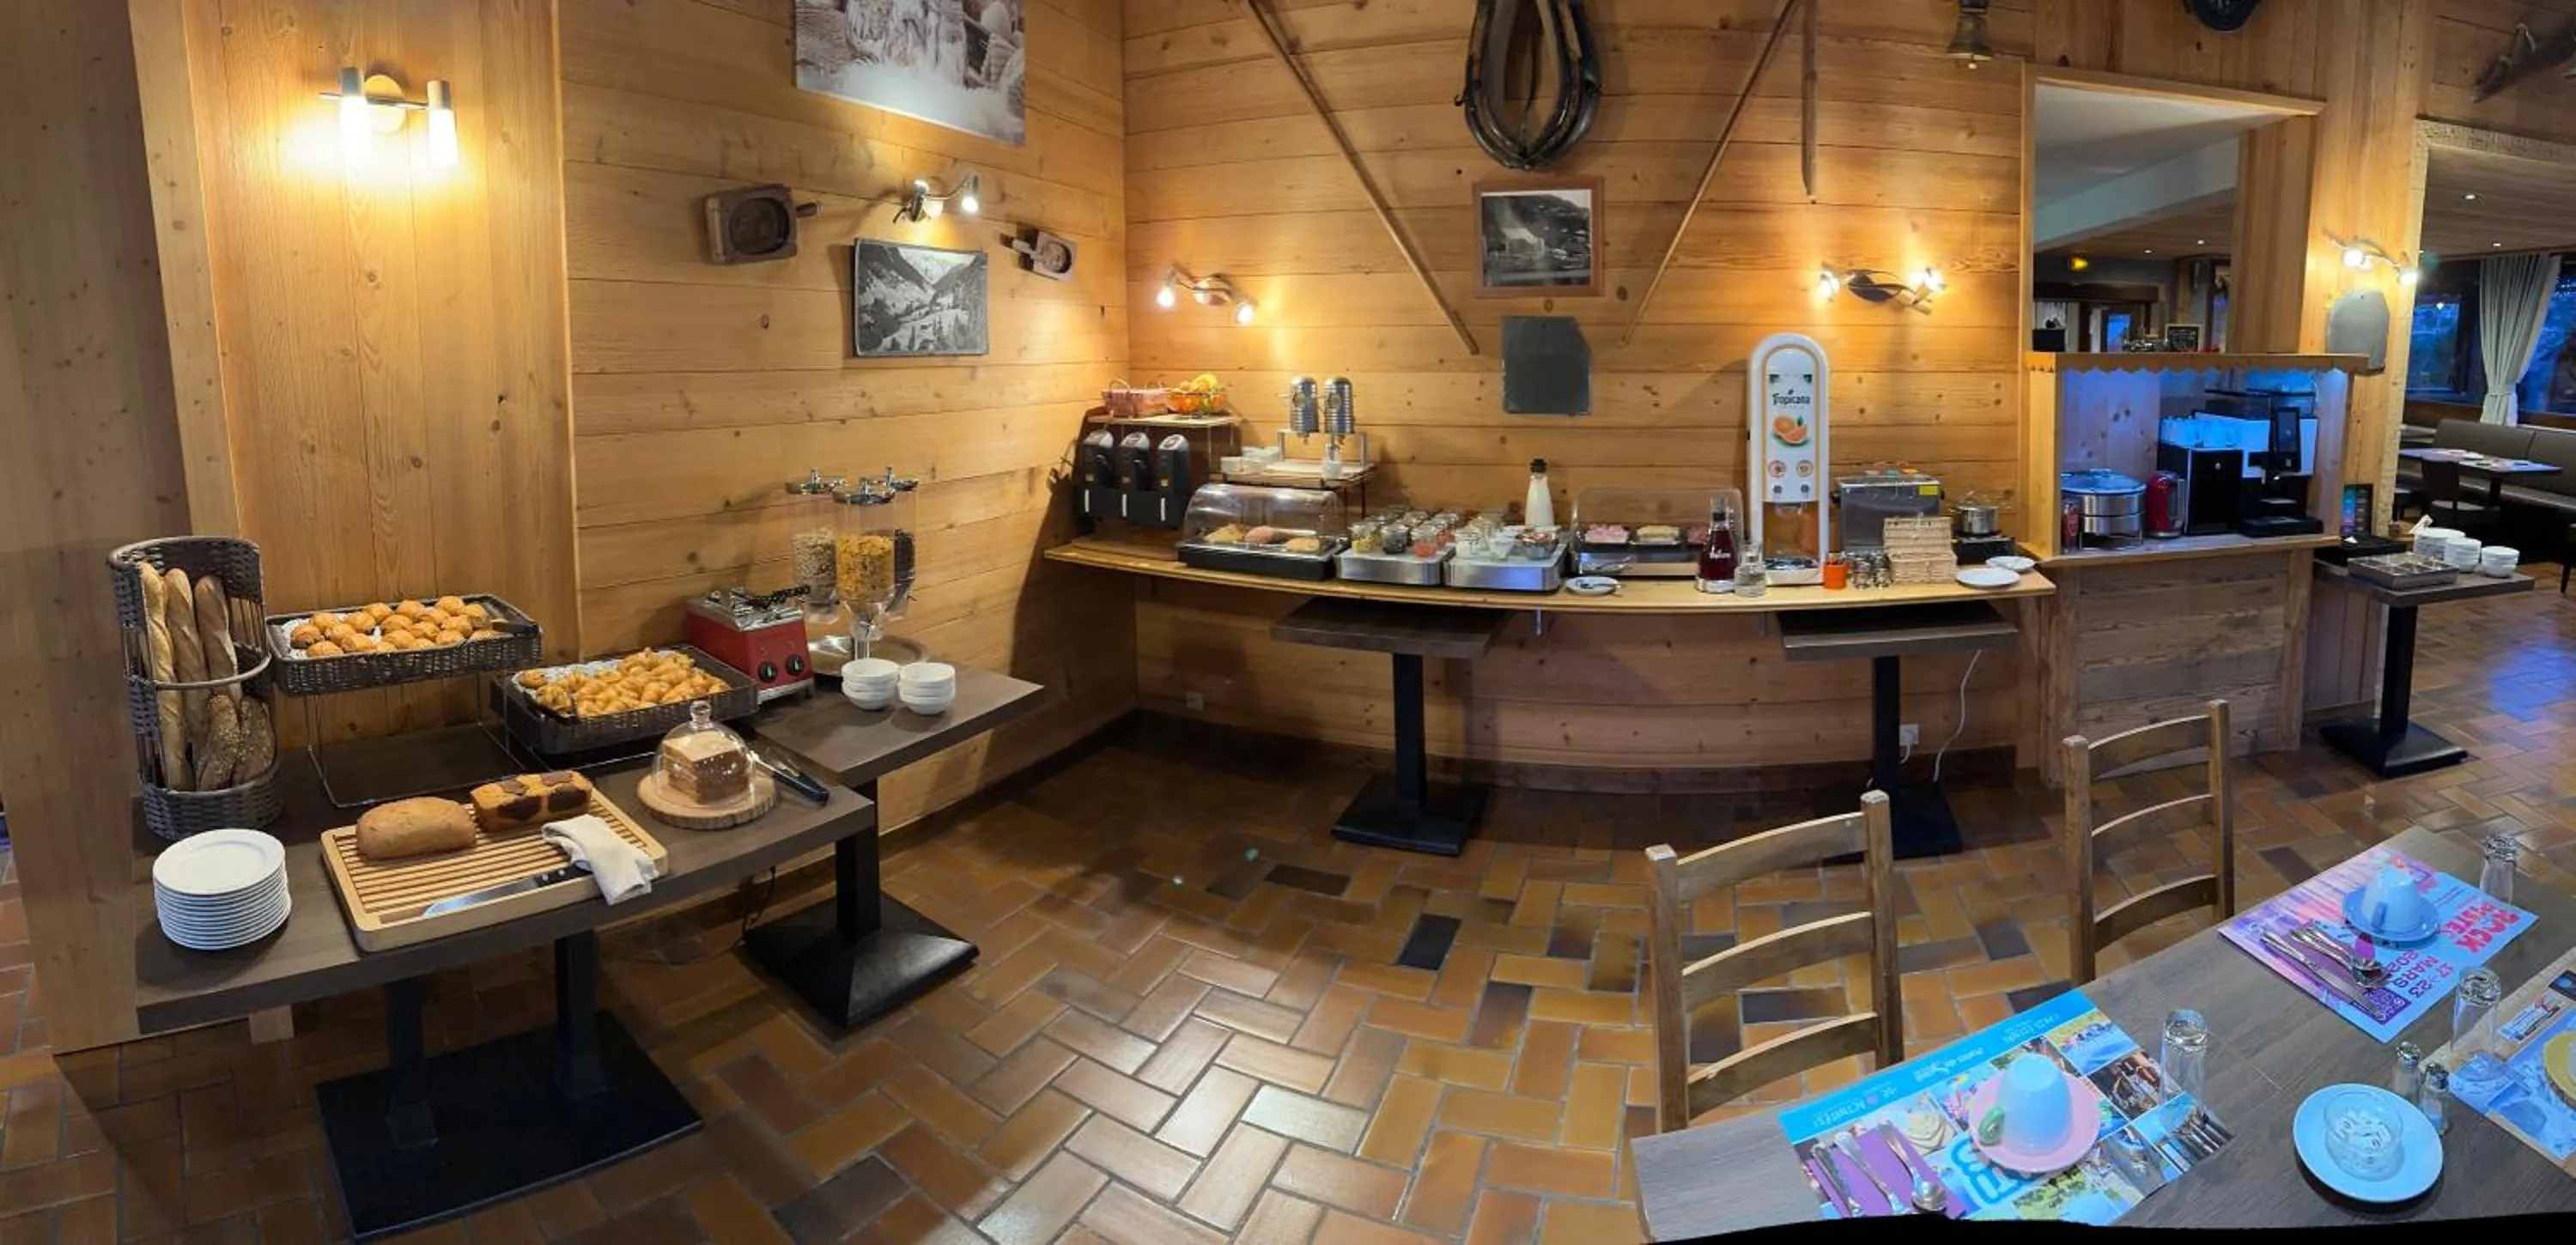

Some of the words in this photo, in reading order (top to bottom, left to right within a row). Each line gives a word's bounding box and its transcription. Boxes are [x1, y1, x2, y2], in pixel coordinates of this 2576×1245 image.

[1771, 392, 1811, 406] Tropicana
[2385, 950, 2419, 973] 202
[2392, 955, 2439, 988] MARS
